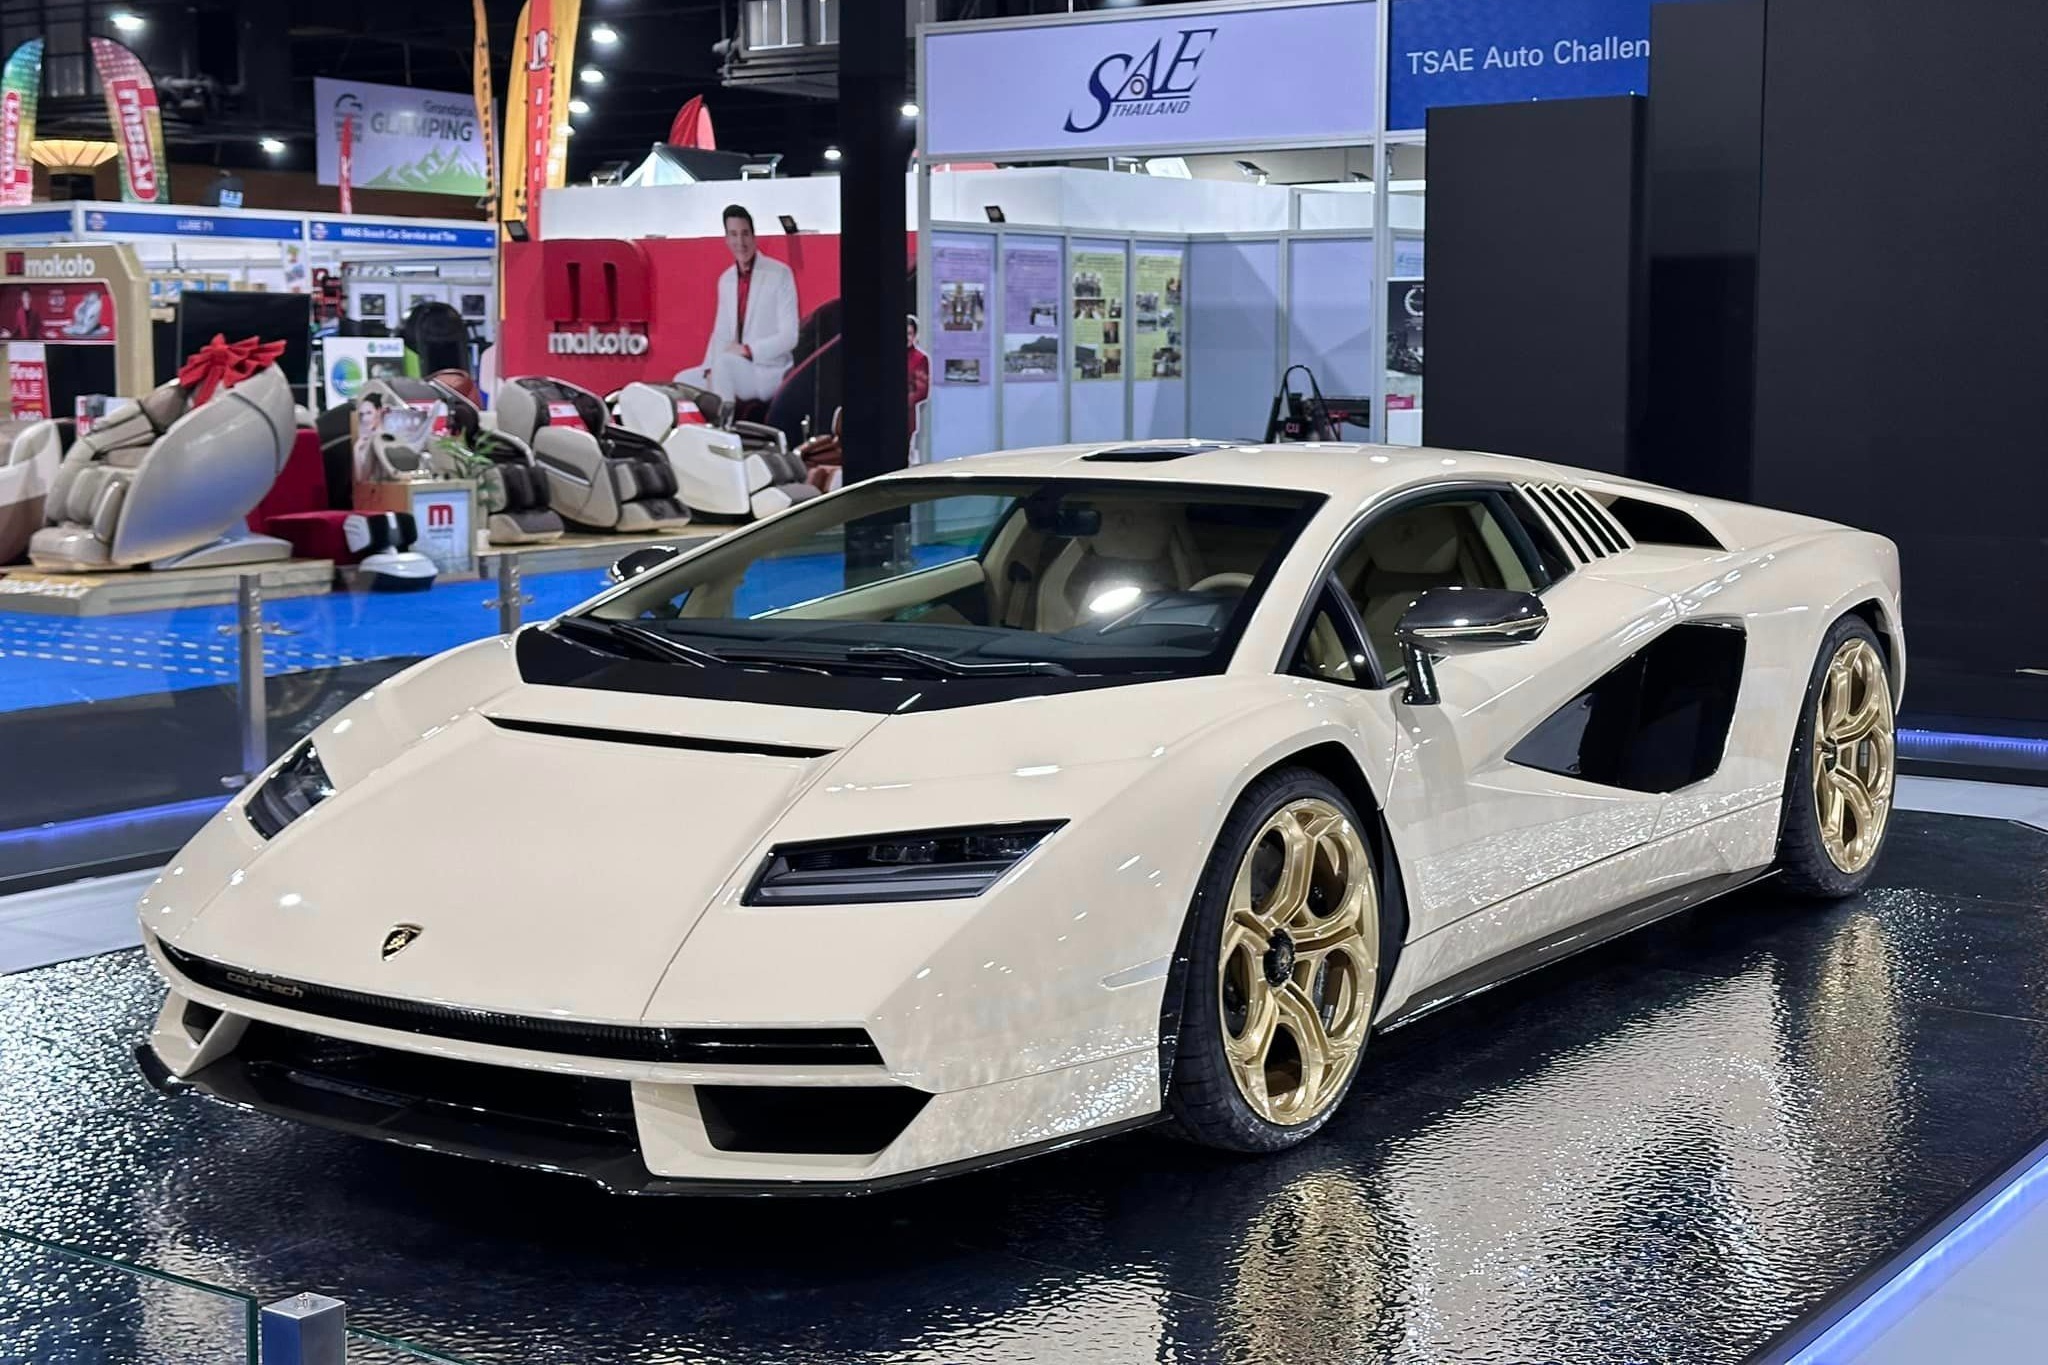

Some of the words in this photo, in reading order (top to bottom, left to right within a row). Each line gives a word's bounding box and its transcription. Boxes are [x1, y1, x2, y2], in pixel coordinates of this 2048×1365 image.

[1407, 48, 1474, 75] TSAE
[1483, 46, 1544, 70] Auto
[1064, 28, 1217, 133] SAE
[1112, 101, 1190, 117] THAILAND
[400, 229, 427, 241] Service
[25, 253, 95, 278] makoto
[548, 326, 648, 355] makoto
[226, 971, 304, 998] countach
